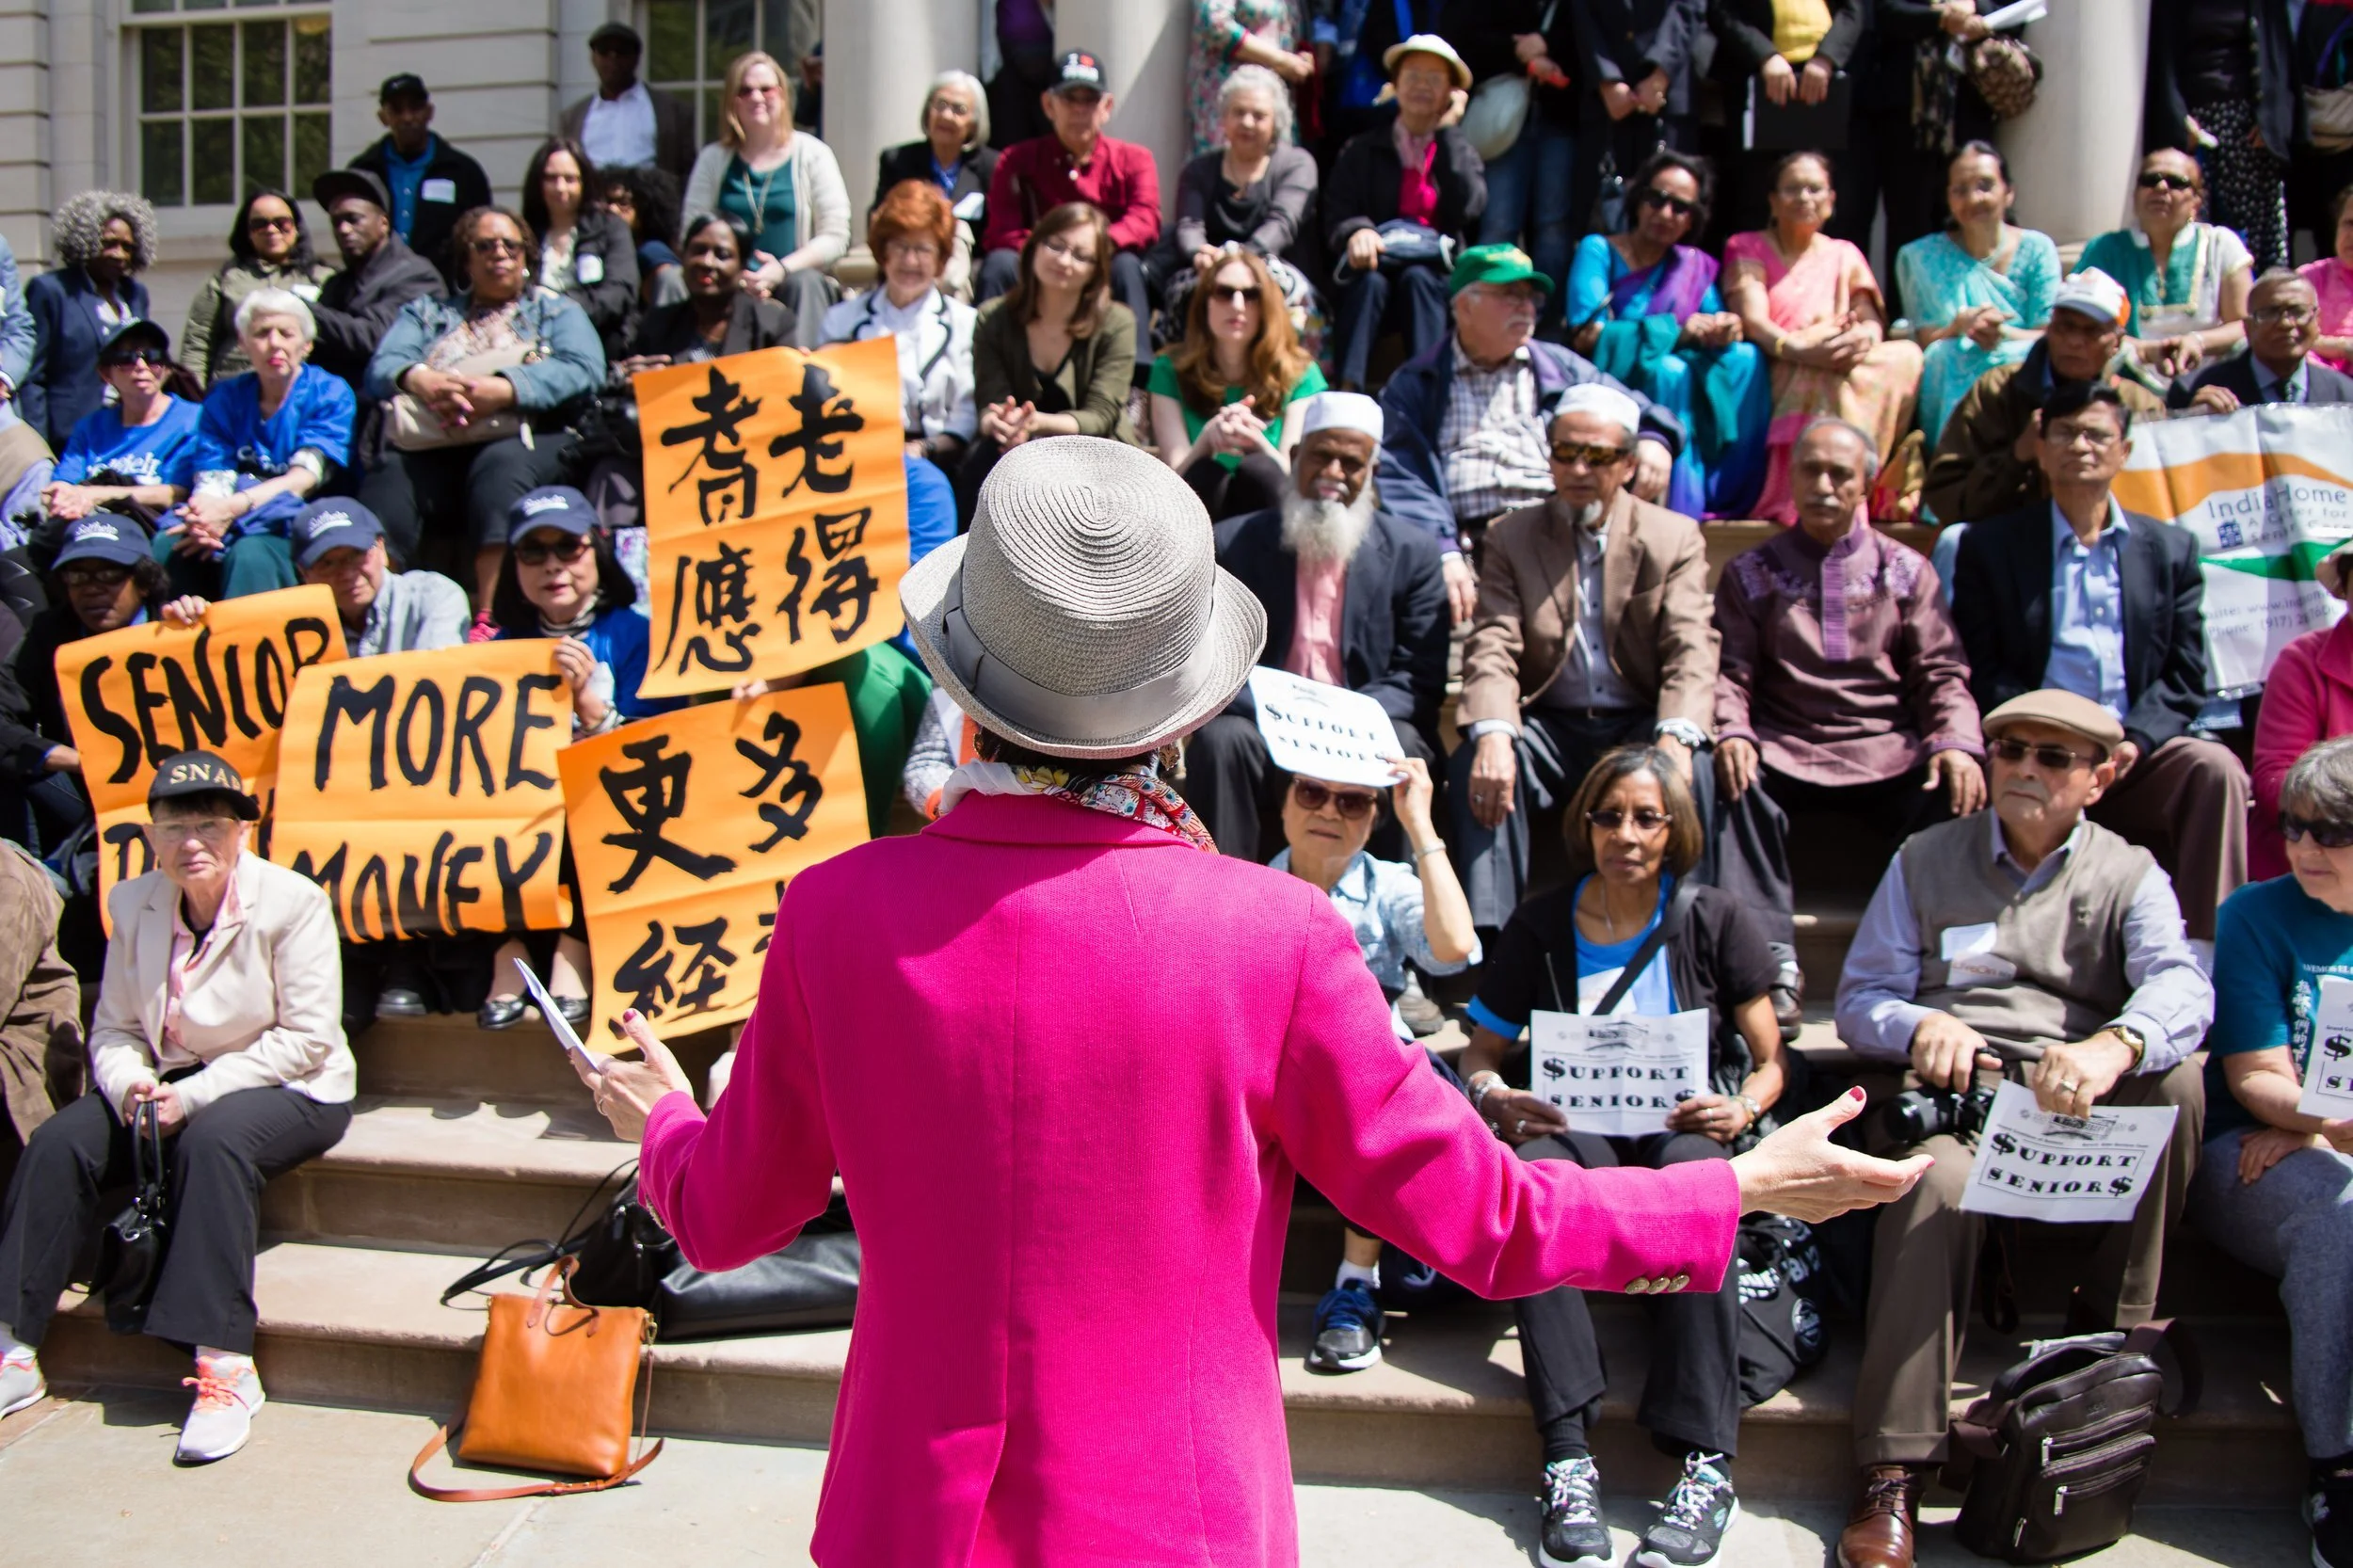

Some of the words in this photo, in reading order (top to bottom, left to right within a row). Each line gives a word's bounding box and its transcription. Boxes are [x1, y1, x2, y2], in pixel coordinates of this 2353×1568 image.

[314, 673, 563, 797] MORE
[600, 712, 824, 894] 更多
[291, 830, 553, 944] MONEY
